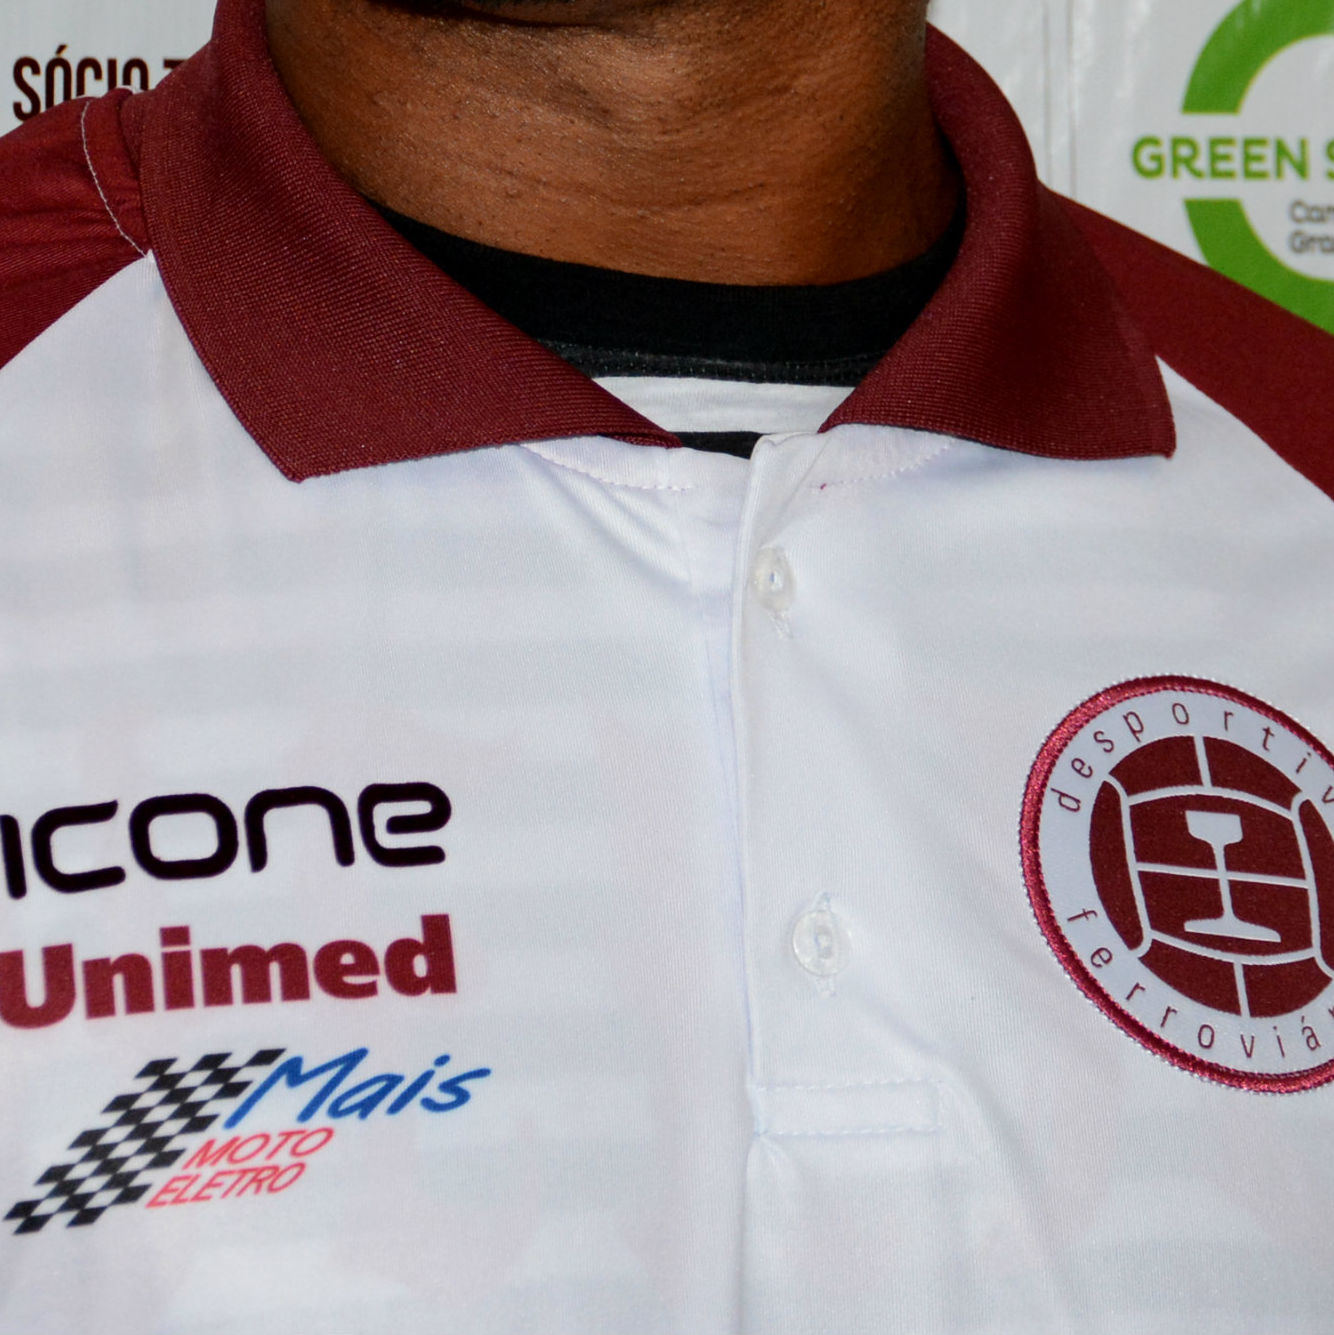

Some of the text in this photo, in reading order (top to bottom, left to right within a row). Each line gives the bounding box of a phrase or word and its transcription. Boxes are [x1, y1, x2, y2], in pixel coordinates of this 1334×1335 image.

[1132, 135, 1310, 182] GREEN
[223, 1047, 491, 1130] Mais
[183, 1127, 335, 1170] MOTO
[146, 1163, 306, 1210] ELETRO
